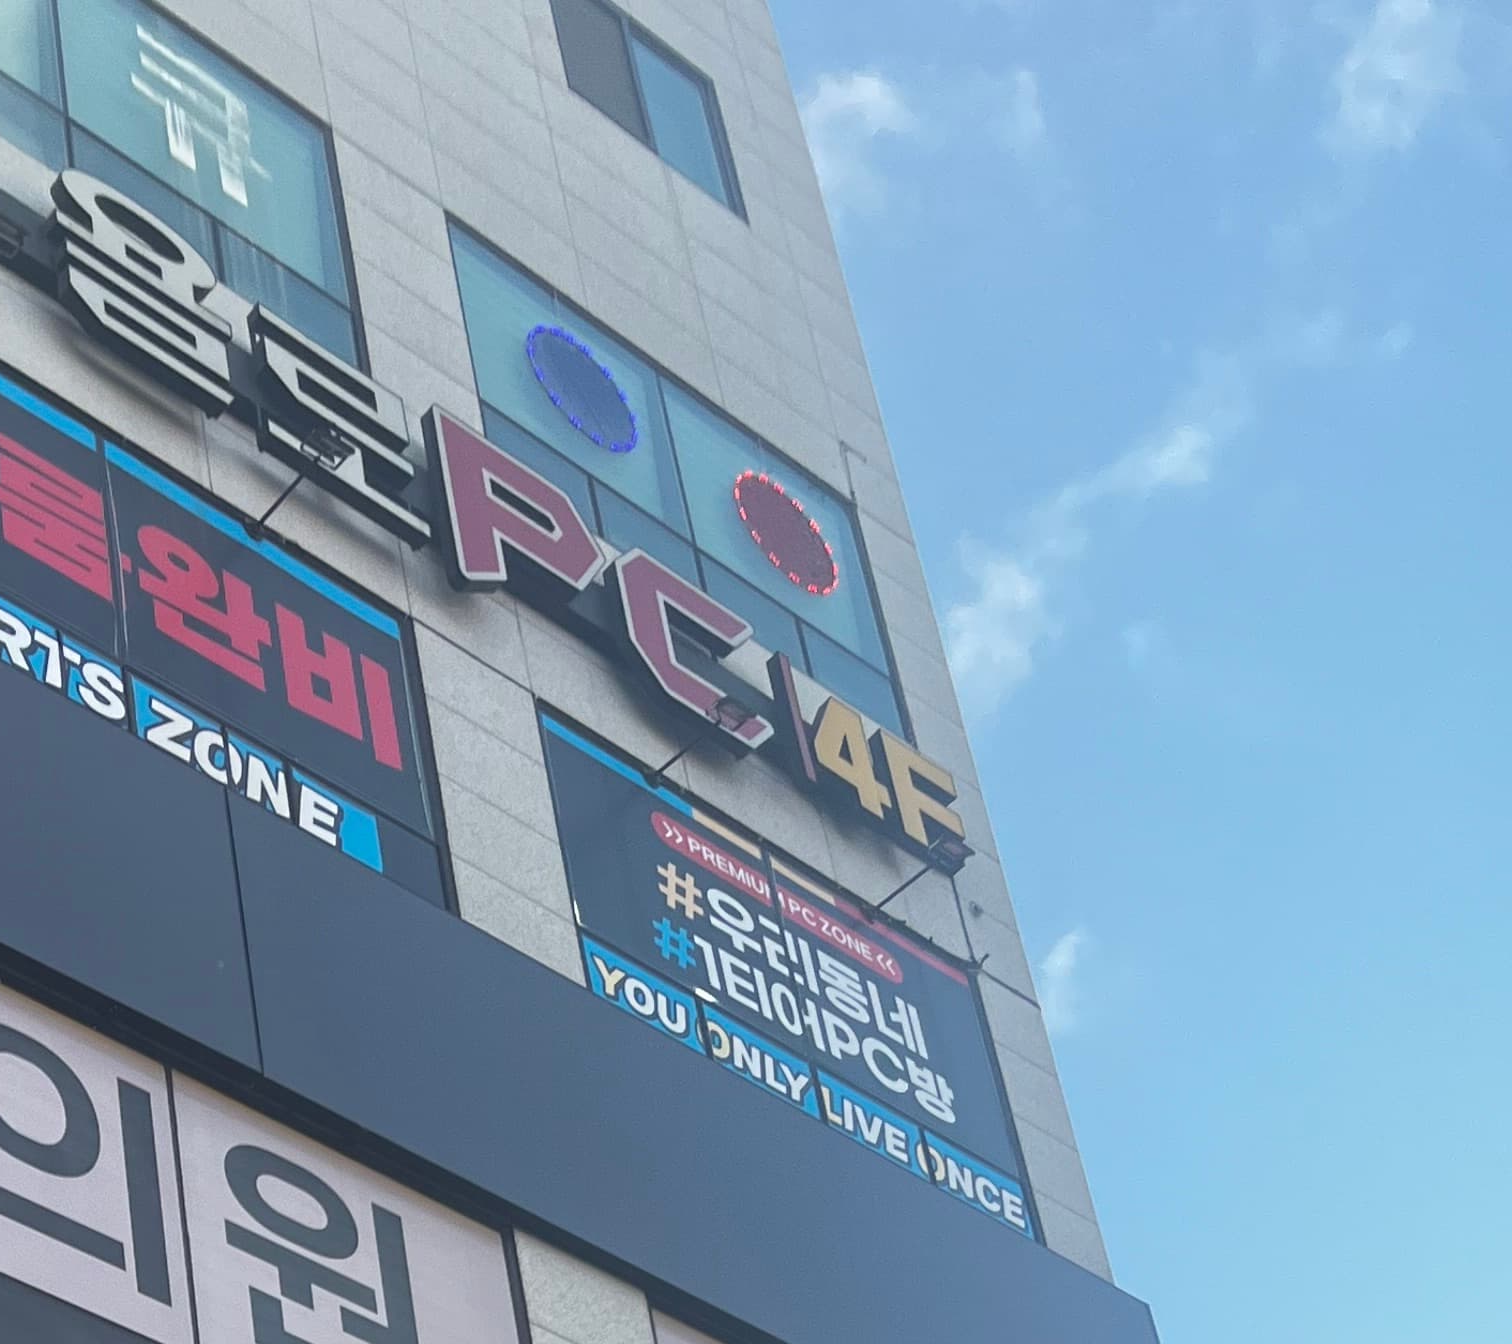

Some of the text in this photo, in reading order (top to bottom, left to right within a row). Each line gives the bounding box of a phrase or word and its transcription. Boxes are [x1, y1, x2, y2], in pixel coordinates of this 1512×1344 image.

[146, 699, 342, 847] ZONE
[688, 839, 785, 912] PREMIU
[818, 919, 873, 962] ZONE
[592, 955, 1027, 1229] YOU ONLY LIVE ONCE
